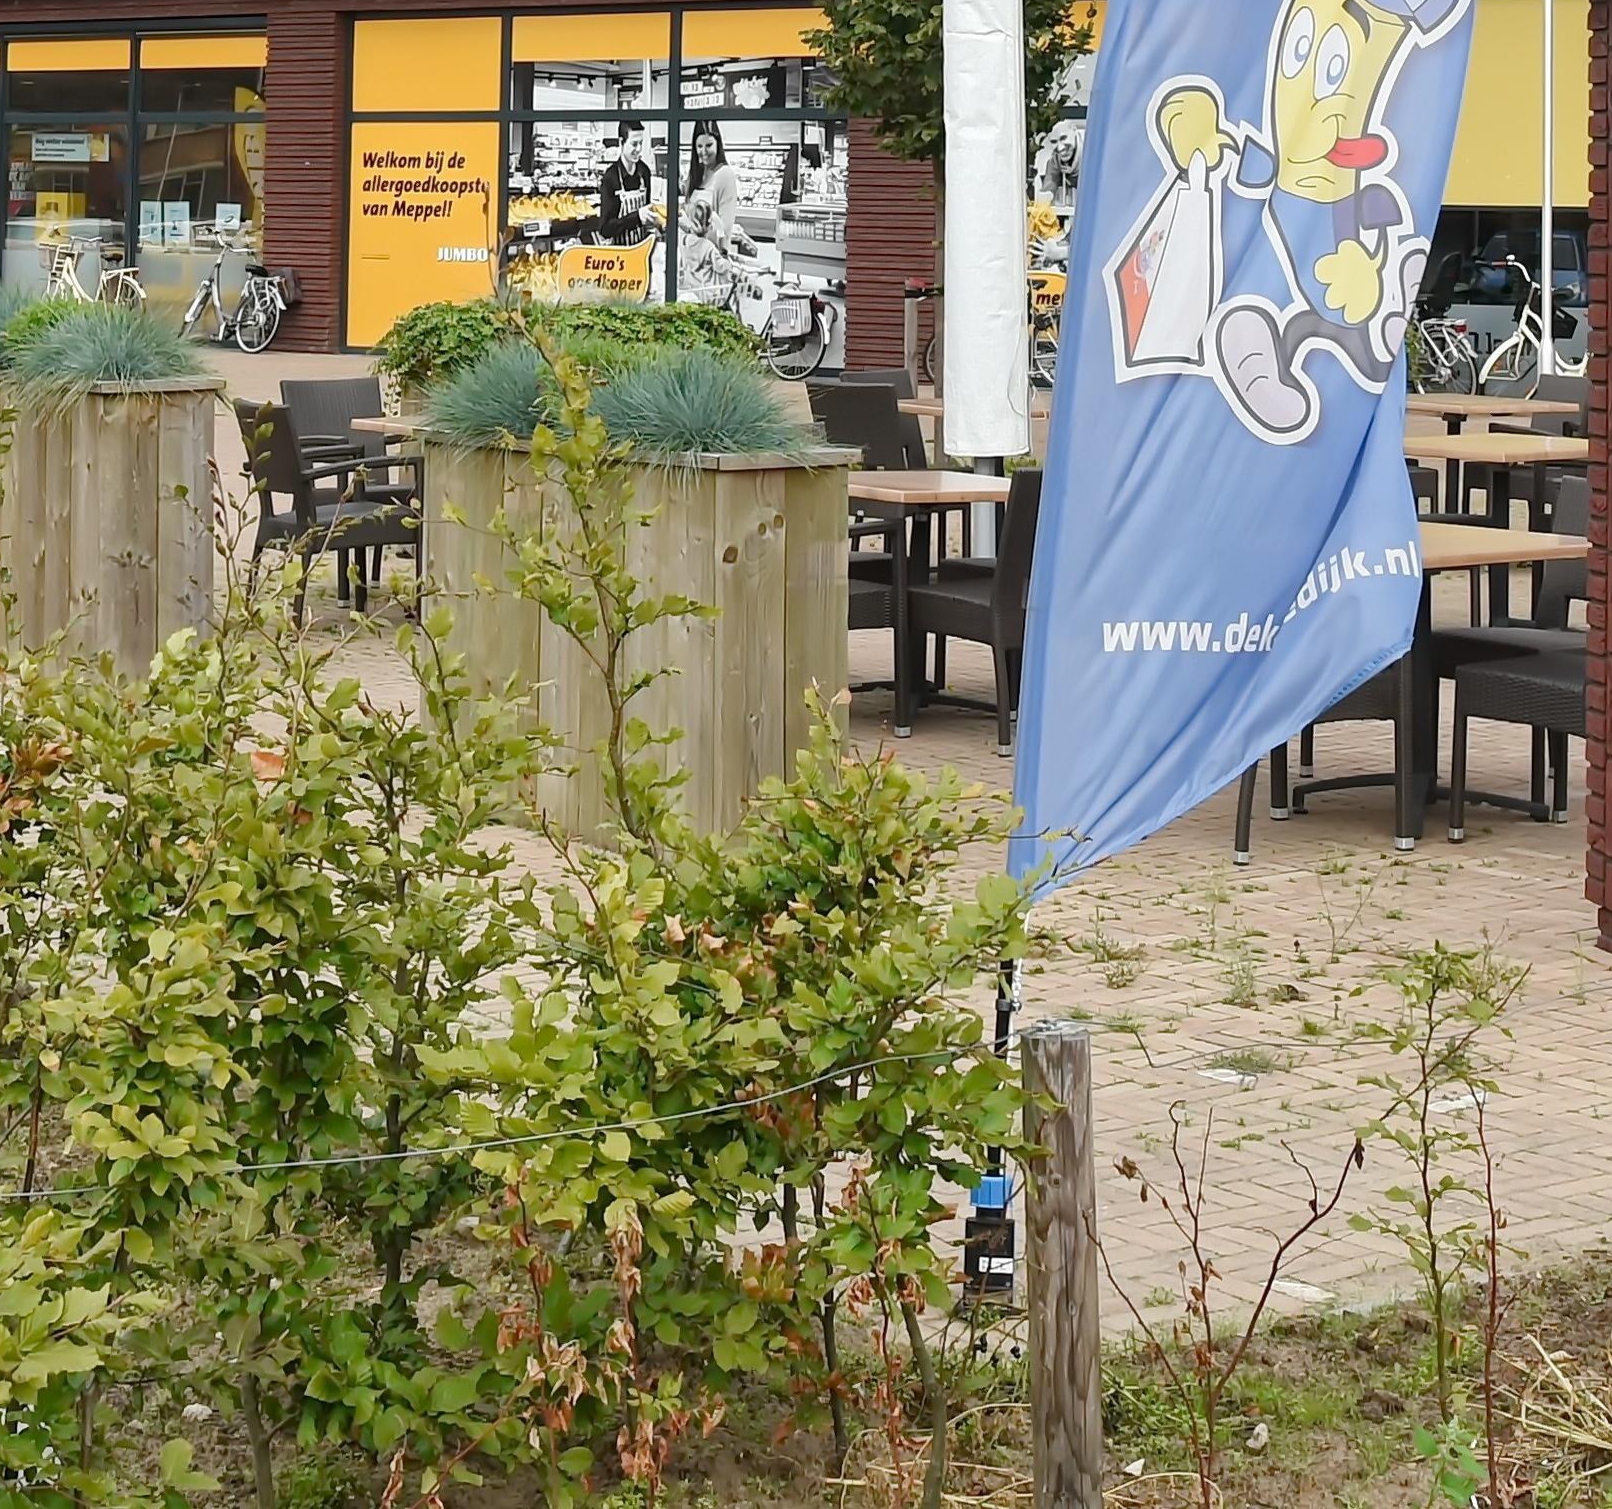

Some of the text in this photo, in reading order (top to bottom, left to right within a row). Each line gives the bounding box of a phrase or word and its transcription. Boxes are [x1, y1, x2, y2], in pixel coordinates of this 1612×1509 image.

[362, 151, 466, 174] Welkom bij de
[362, 200, 453, 222] van Meppel!
[436, 247, 489, 262] JUMBO
[584, 255, 625, 271] Euro's
[1035, 292, 1064, 305] me
[1102, 541, 1420, 653] www.dekdijk.nl
